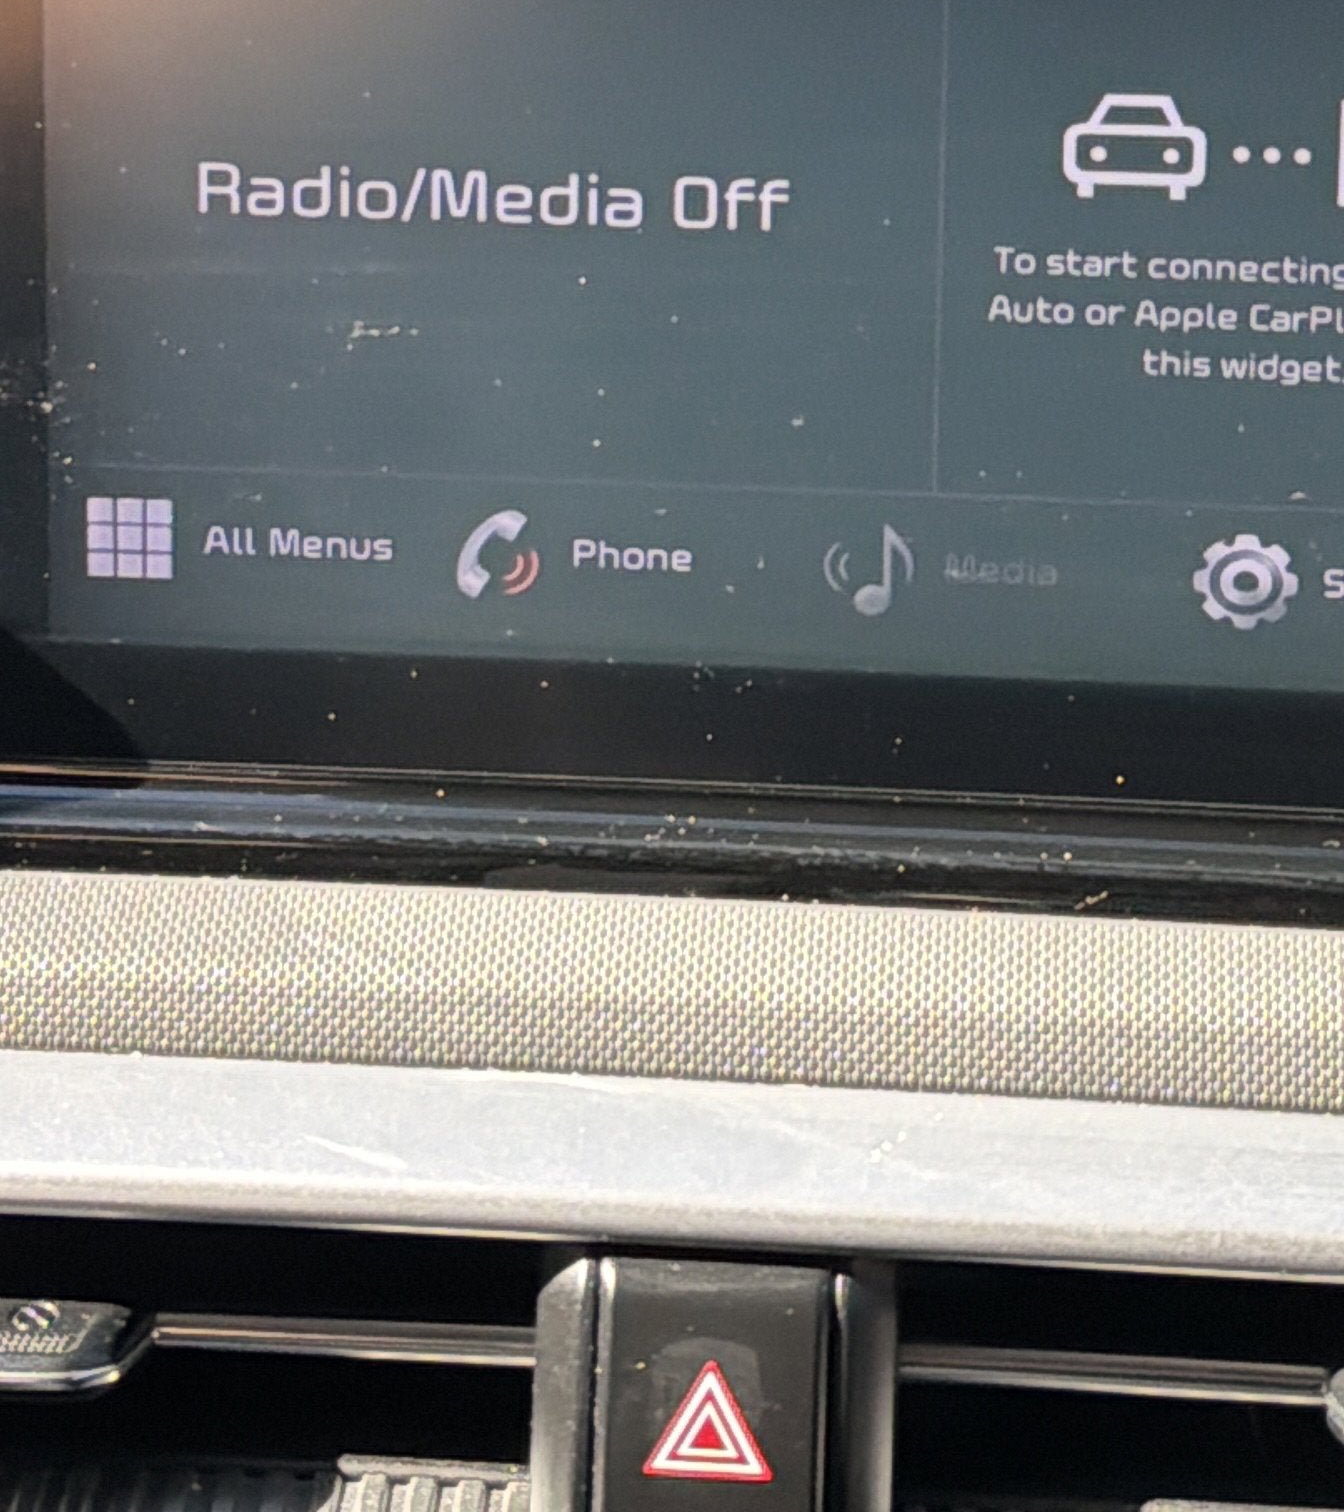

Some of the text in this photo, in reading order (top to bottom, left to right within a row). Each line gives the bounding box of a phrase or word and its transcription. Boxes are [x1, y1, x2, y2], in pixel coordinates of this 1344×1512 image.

[199, 162, 789, 231] Radio/Media Off
[994, 246, 1036, 274] To
[1047, 250, 1137, 278] start
[989, 295, 1074, 324] Auto
[1085, 305, 1125, 325] or
[1135, 300, 1237, 332] Apple
[1143, 350, 1210, 377] this
[204, 526, 392, 560] All Menus
[574, 539, 692, 571] Phone
[944, 553, 1058, 585] Media
